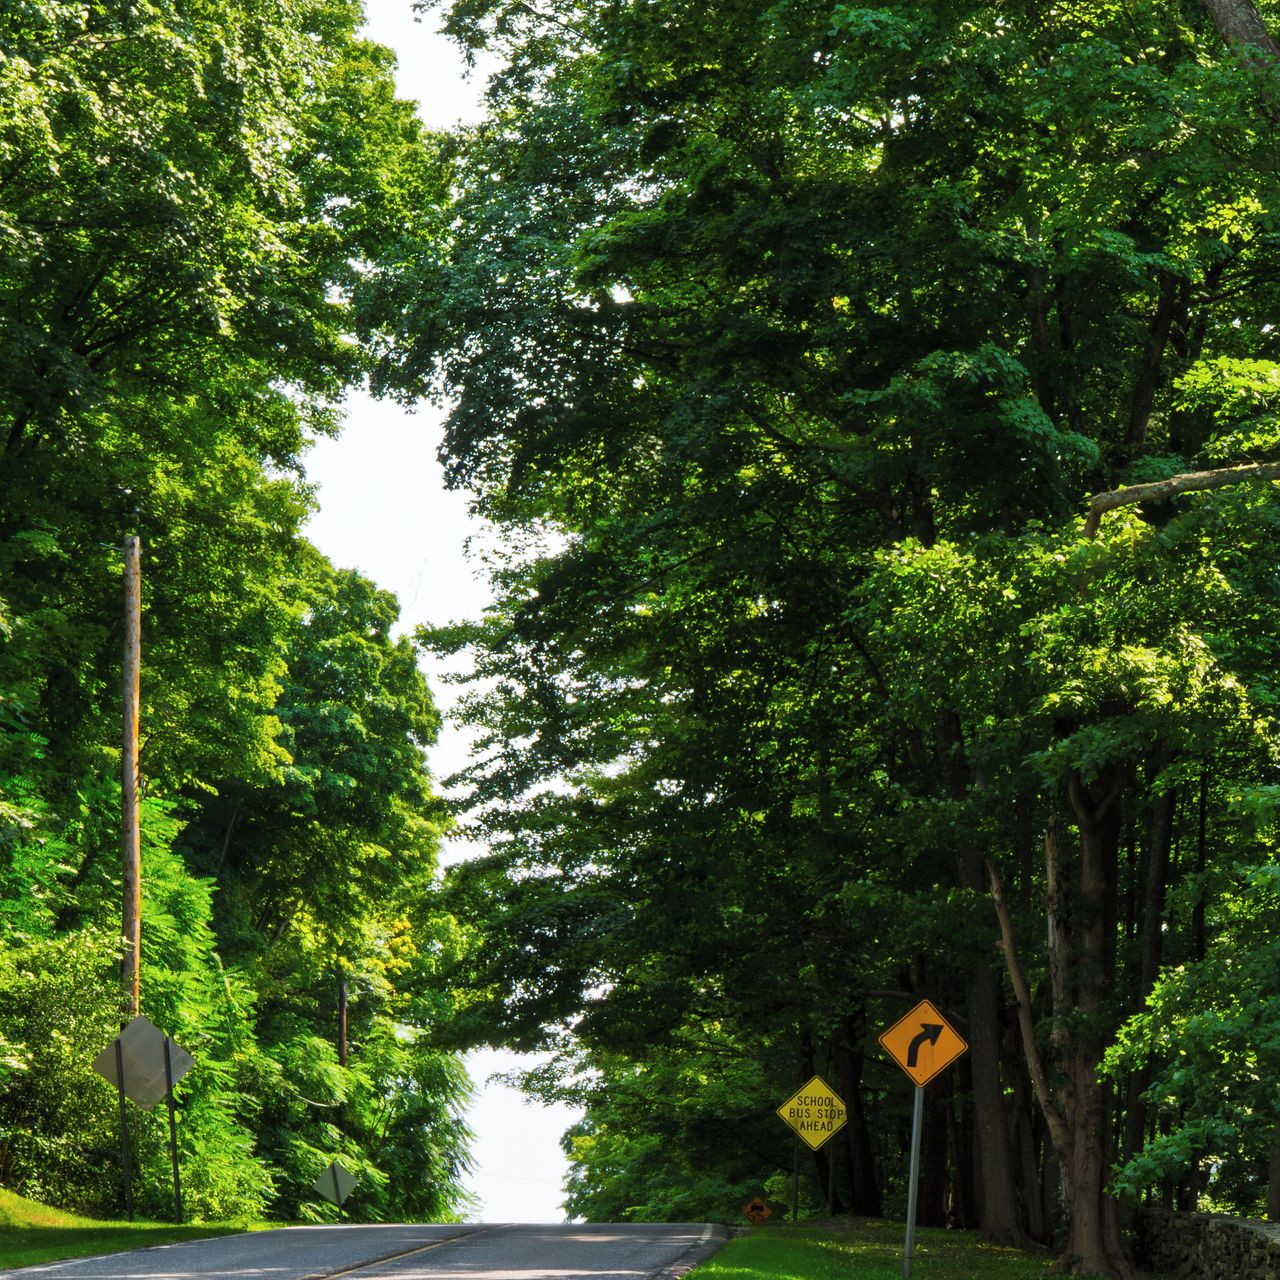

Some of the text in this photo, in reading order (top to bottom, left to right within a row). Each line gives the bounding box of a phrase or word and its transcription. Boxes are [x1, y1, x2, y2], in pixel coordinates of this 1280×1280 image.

[797, 1095, 836, 1107] SCHOOL
[789, 1107, 844, 1120] BUS STOP
[799, 1120, 833, 1132] AHEAD
